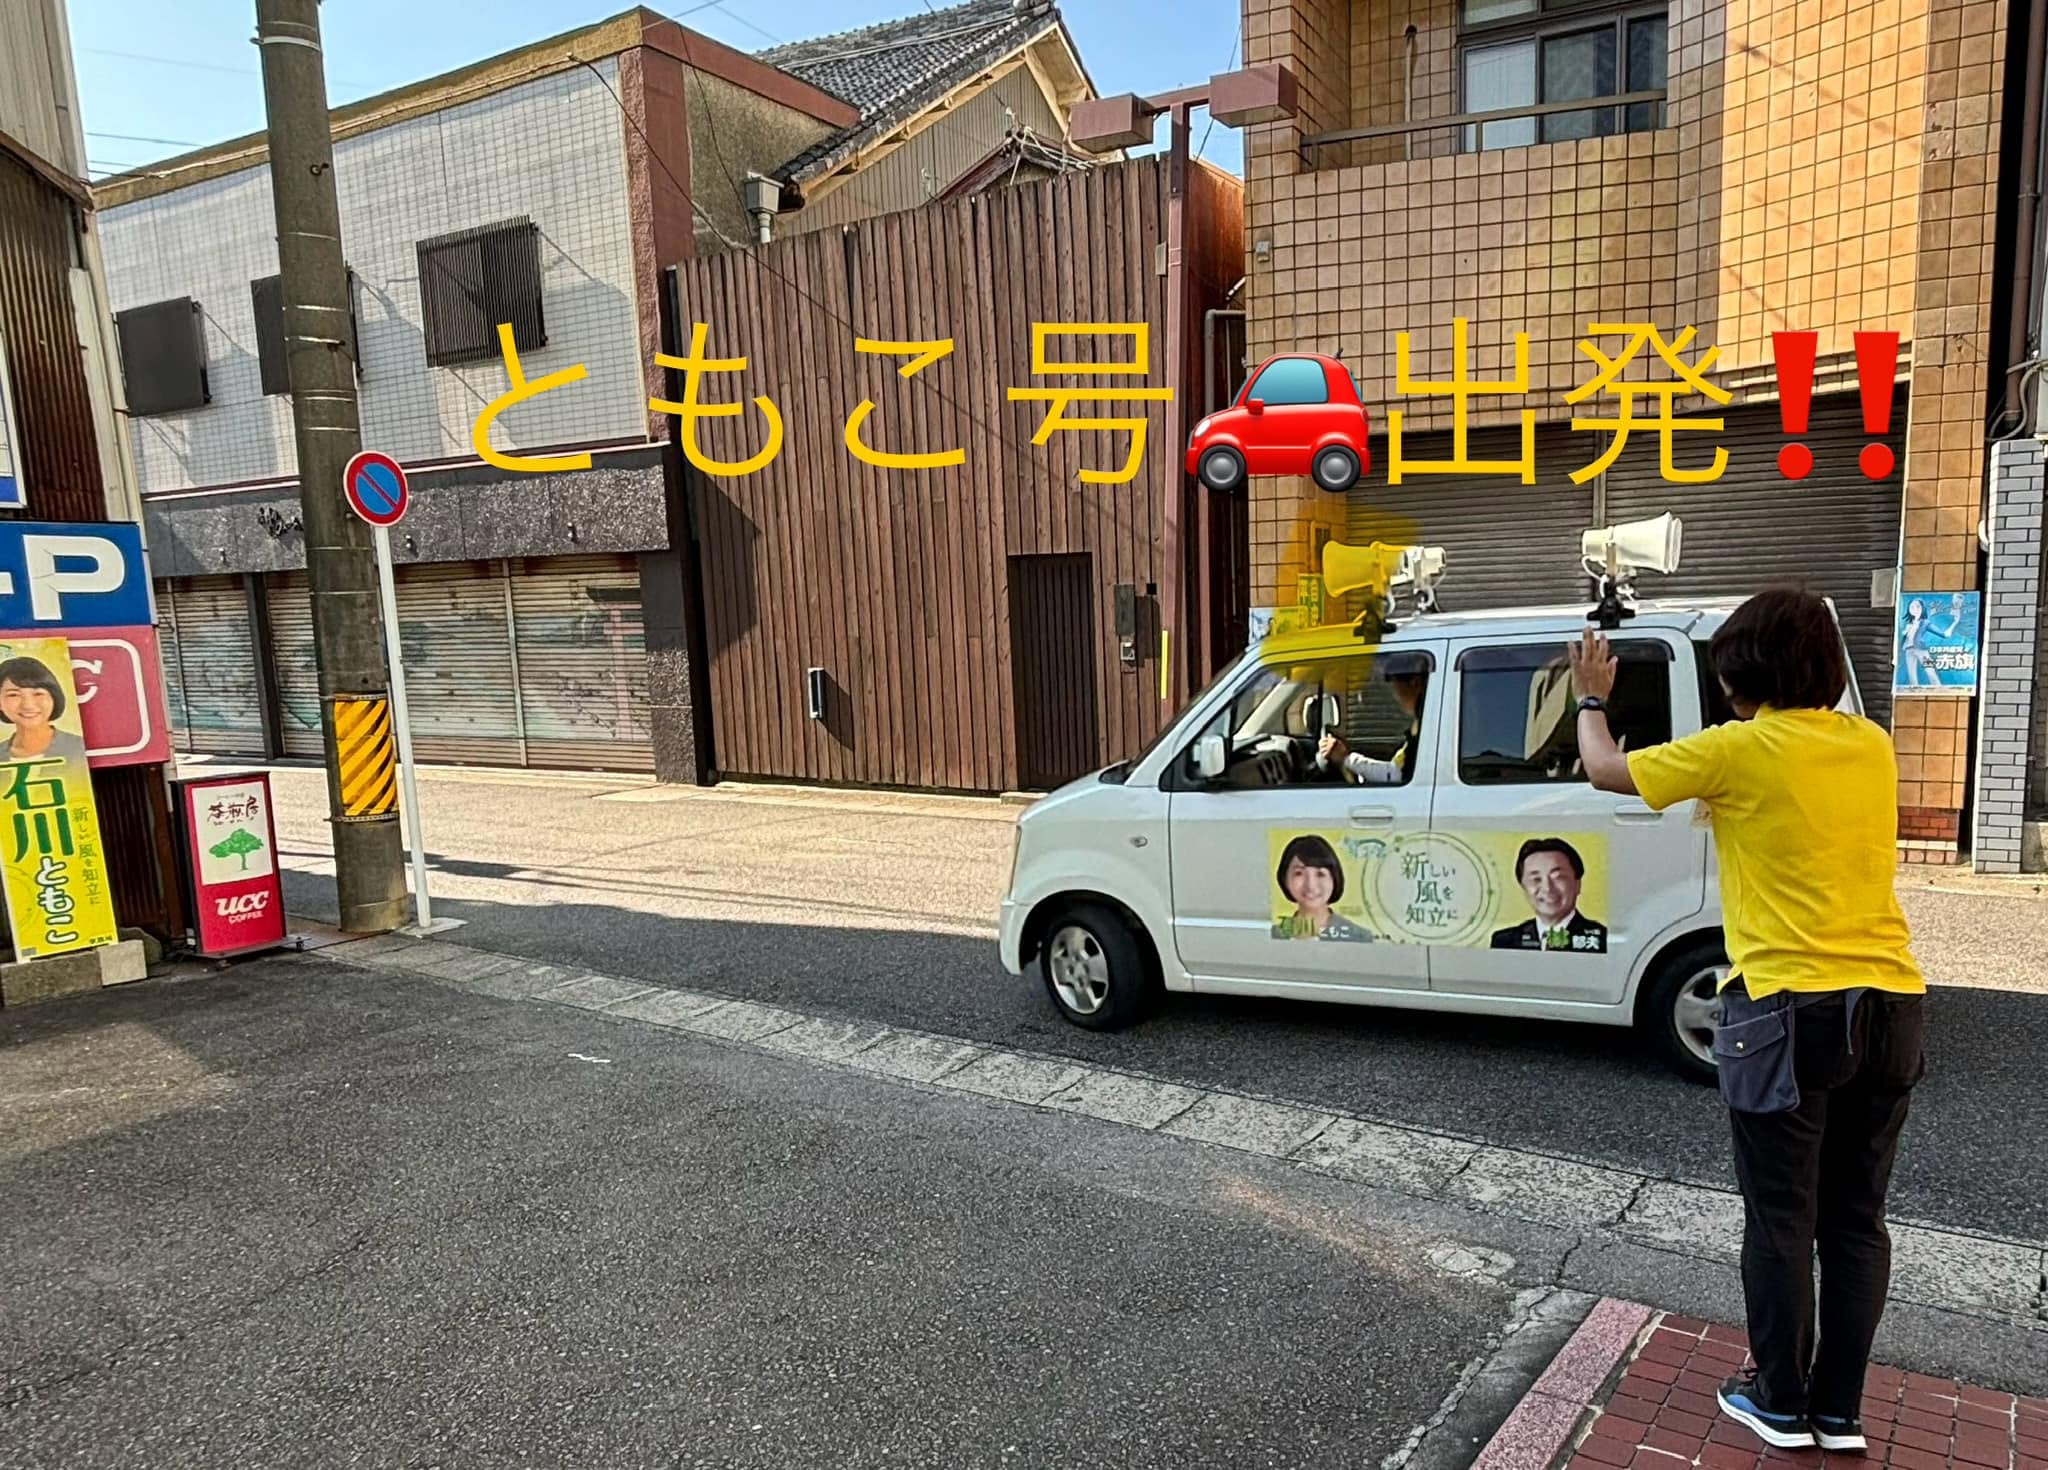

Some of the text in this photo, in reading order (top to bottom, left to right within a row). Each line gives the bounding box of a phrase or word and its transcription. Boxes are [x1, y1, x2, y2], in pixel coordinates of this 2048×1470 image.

[1402, 851, 1457, 880] 新しい
[1415, 880, 1455, 906] 風を
[1405, 904, 1460, 929] 知立に
